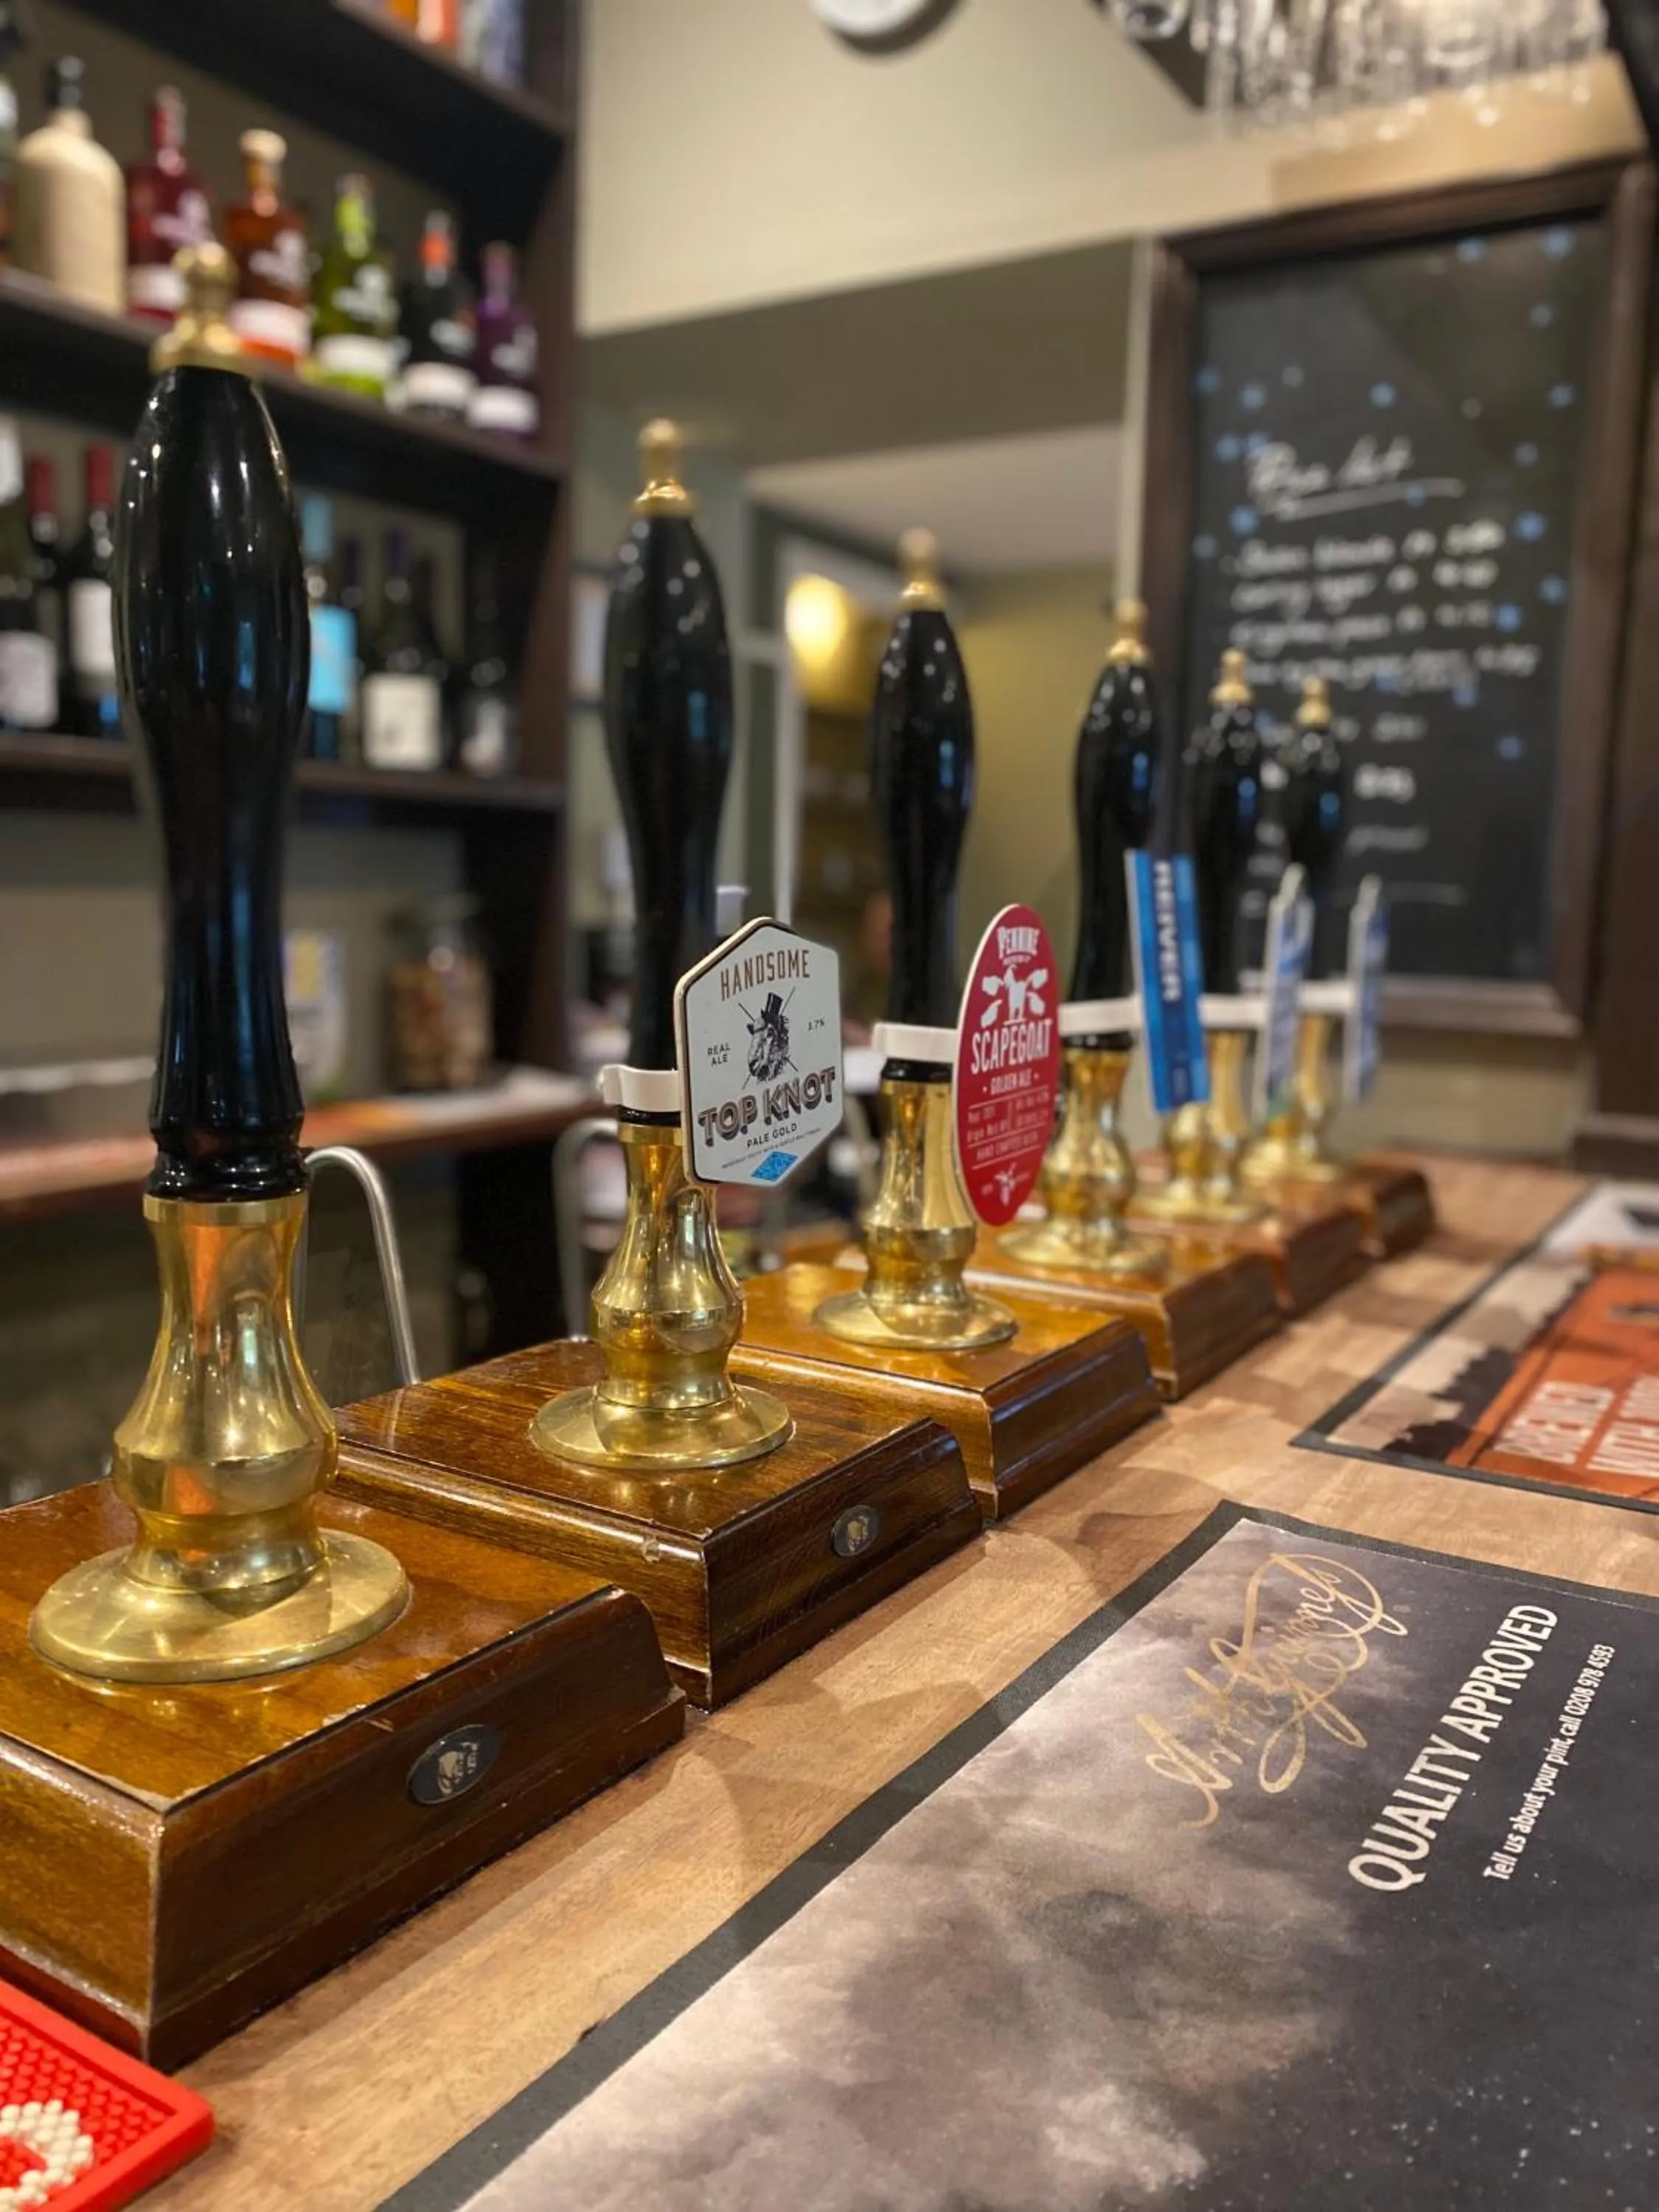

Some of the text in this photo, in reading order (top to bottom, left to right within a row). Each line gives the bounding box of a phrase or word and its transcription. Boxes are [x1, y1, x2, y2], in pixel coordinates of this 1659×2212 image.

[721, 949, 810, 1001] HANDSOME
[707, 1042, 731, 1057] REAL
[711, 1054, 728, 1065] ALE
[971, 1018, 1053, 1075] SCAPEGOAT
[698, 1066, 836, 1147] TOP KNOT
[747, 1133, 769, 1149] PALE
[772, 1123, 797, 1139] GOLD
[1348, 1733, 1482, 1892] QUALITY
[1440, 1604, 1558, 1744] APPROVED
[1482, 1644, 1615, 1880] Tell us about your pint, call 0208 978 4593
